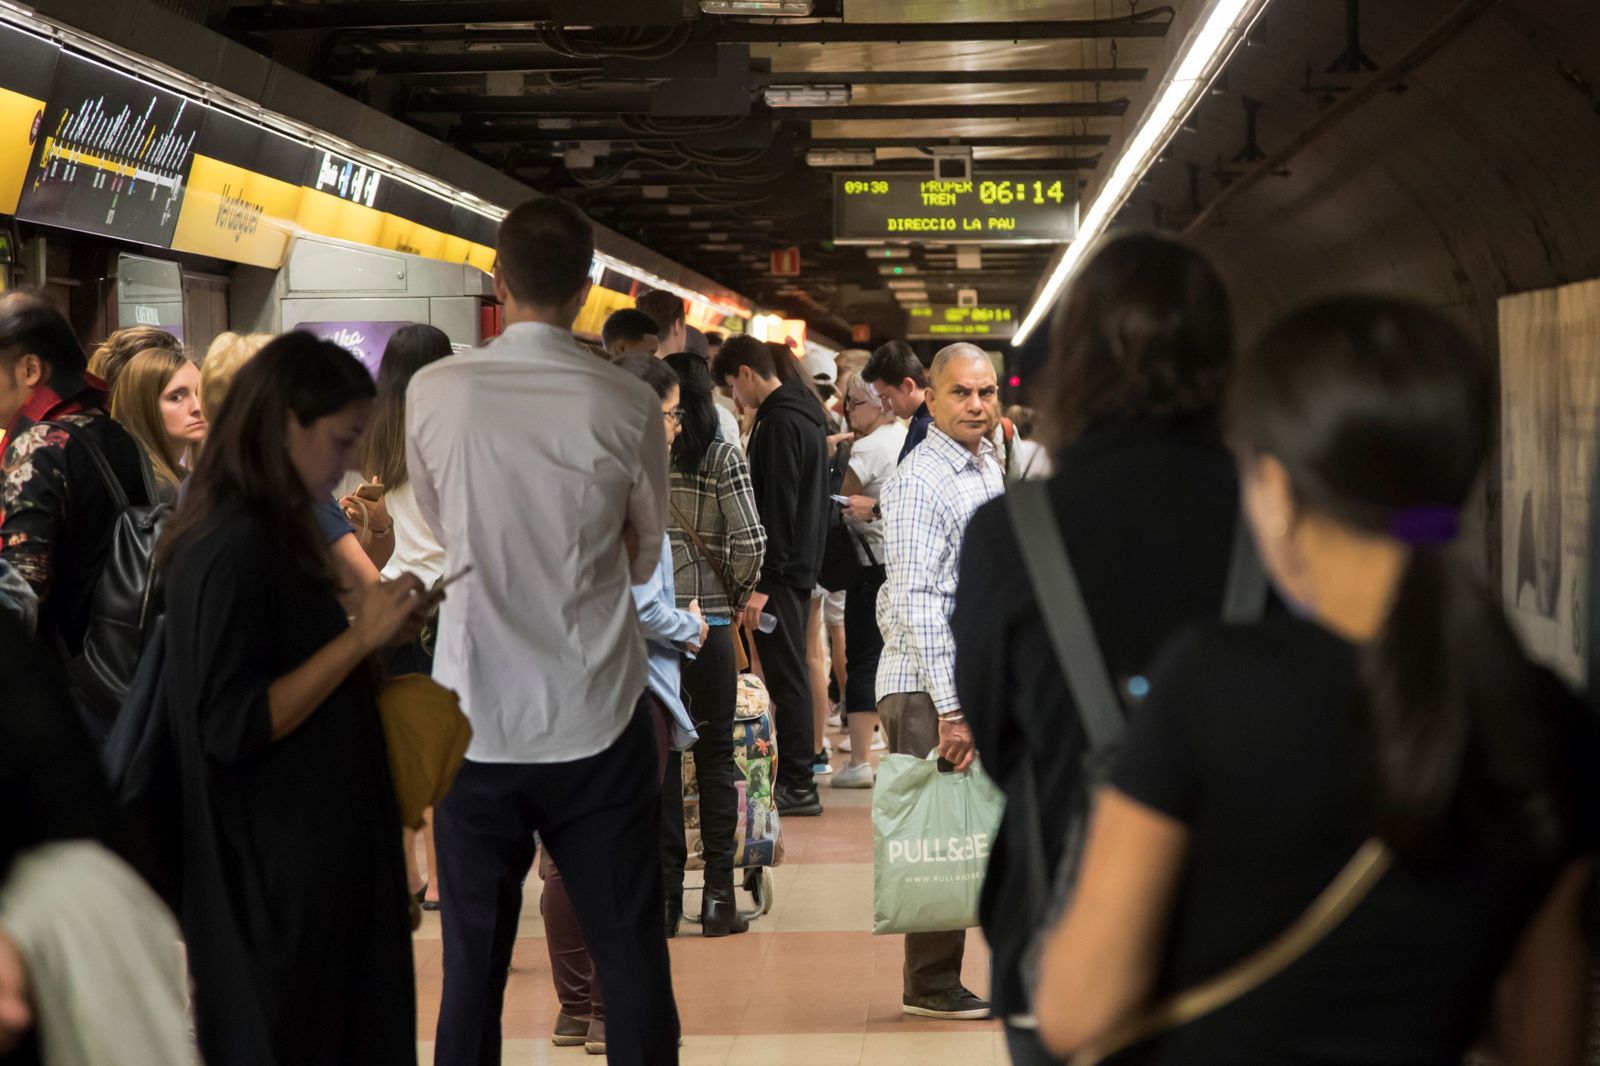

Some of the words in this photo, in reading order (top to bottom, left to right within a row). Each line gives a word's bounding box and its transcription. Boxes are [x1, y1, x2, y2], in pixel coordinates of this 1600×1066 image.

[844, 181, 889, 194] 09:38
[979, 180, 1064, 204] 06:14
[920, 193, 957, 206] TREN
[215, 183, 264, 242] Verdaguer
[963, 217, 982, 231] LA
[988, 217, 1016, 231] PAU
